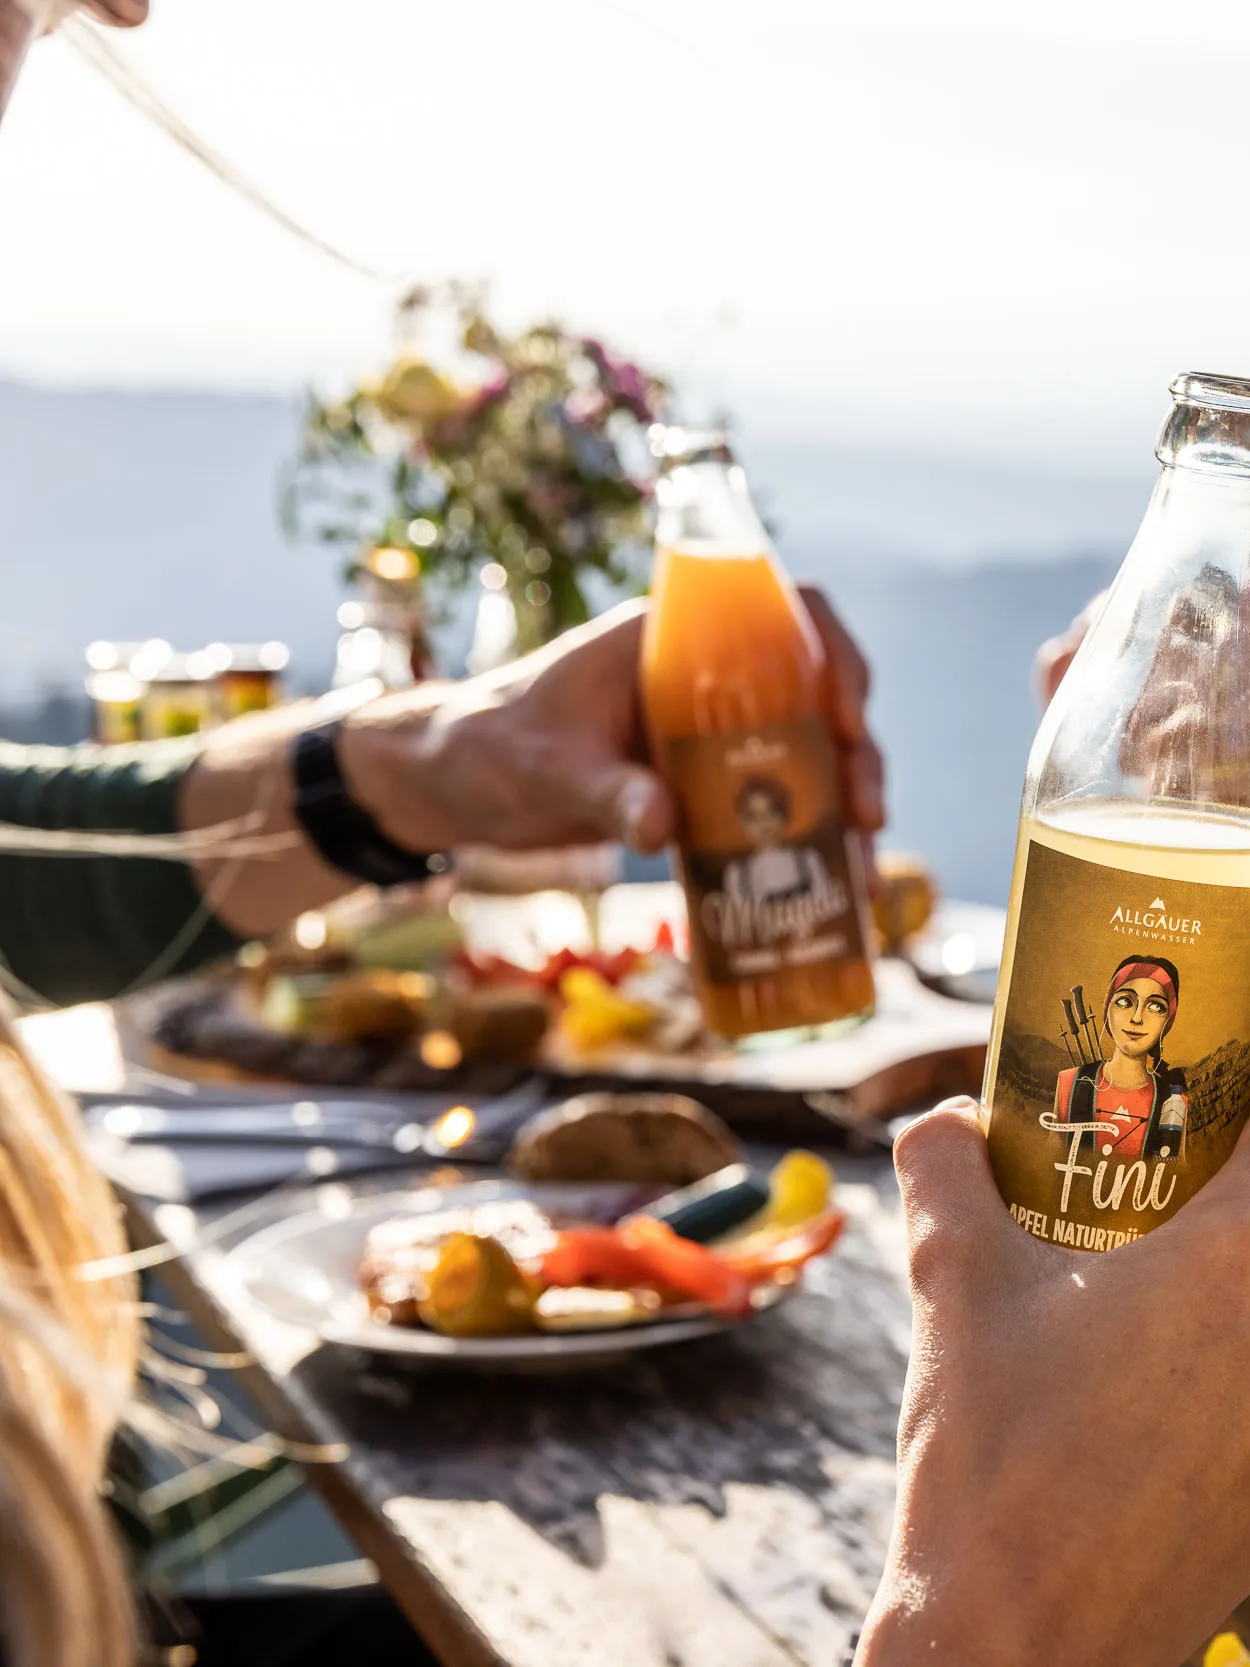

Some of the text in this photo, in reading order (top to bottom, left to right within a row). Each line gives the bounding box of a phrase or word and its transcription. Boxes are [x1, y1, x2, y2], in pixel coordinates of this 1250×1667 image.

[1109, 906, 1202, 935] ALLGÄUER
[1113, 924, 1196, 945] ALPENWASSER
[1039, 1112, 1177, 1213] Fini
[1010, 1202, 1145, 1252] APFEL NATURTRÜ
